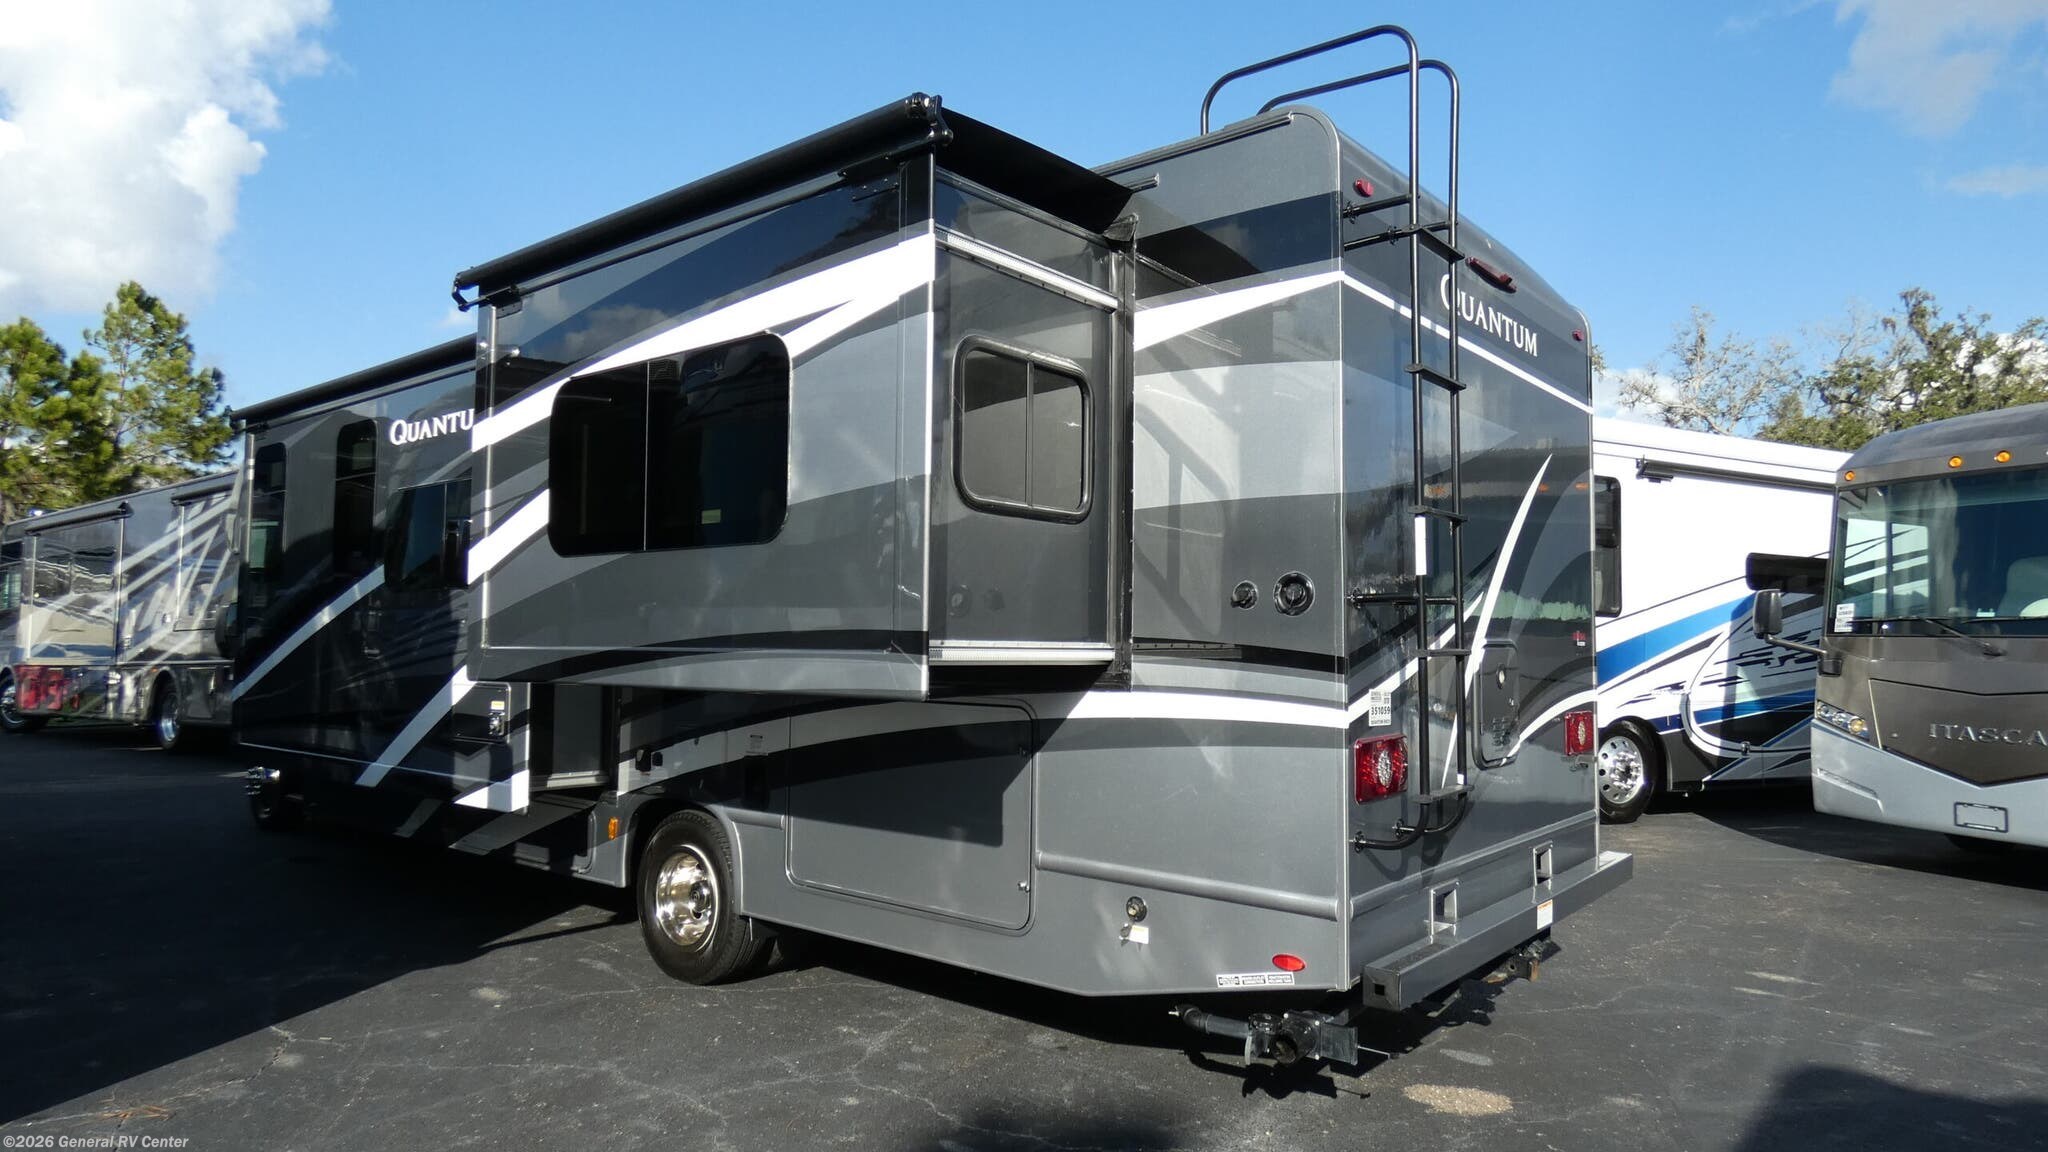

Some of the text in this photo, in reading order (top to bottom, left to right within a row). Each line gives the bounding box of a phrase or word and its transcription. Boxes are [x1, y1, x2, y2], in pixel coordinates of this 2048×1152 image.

[1440, 273, 1538, 357] QUANTUM
[389, 408, 475, 446] QUANTU
[1929, 723, 2048, 746] ITASCA
